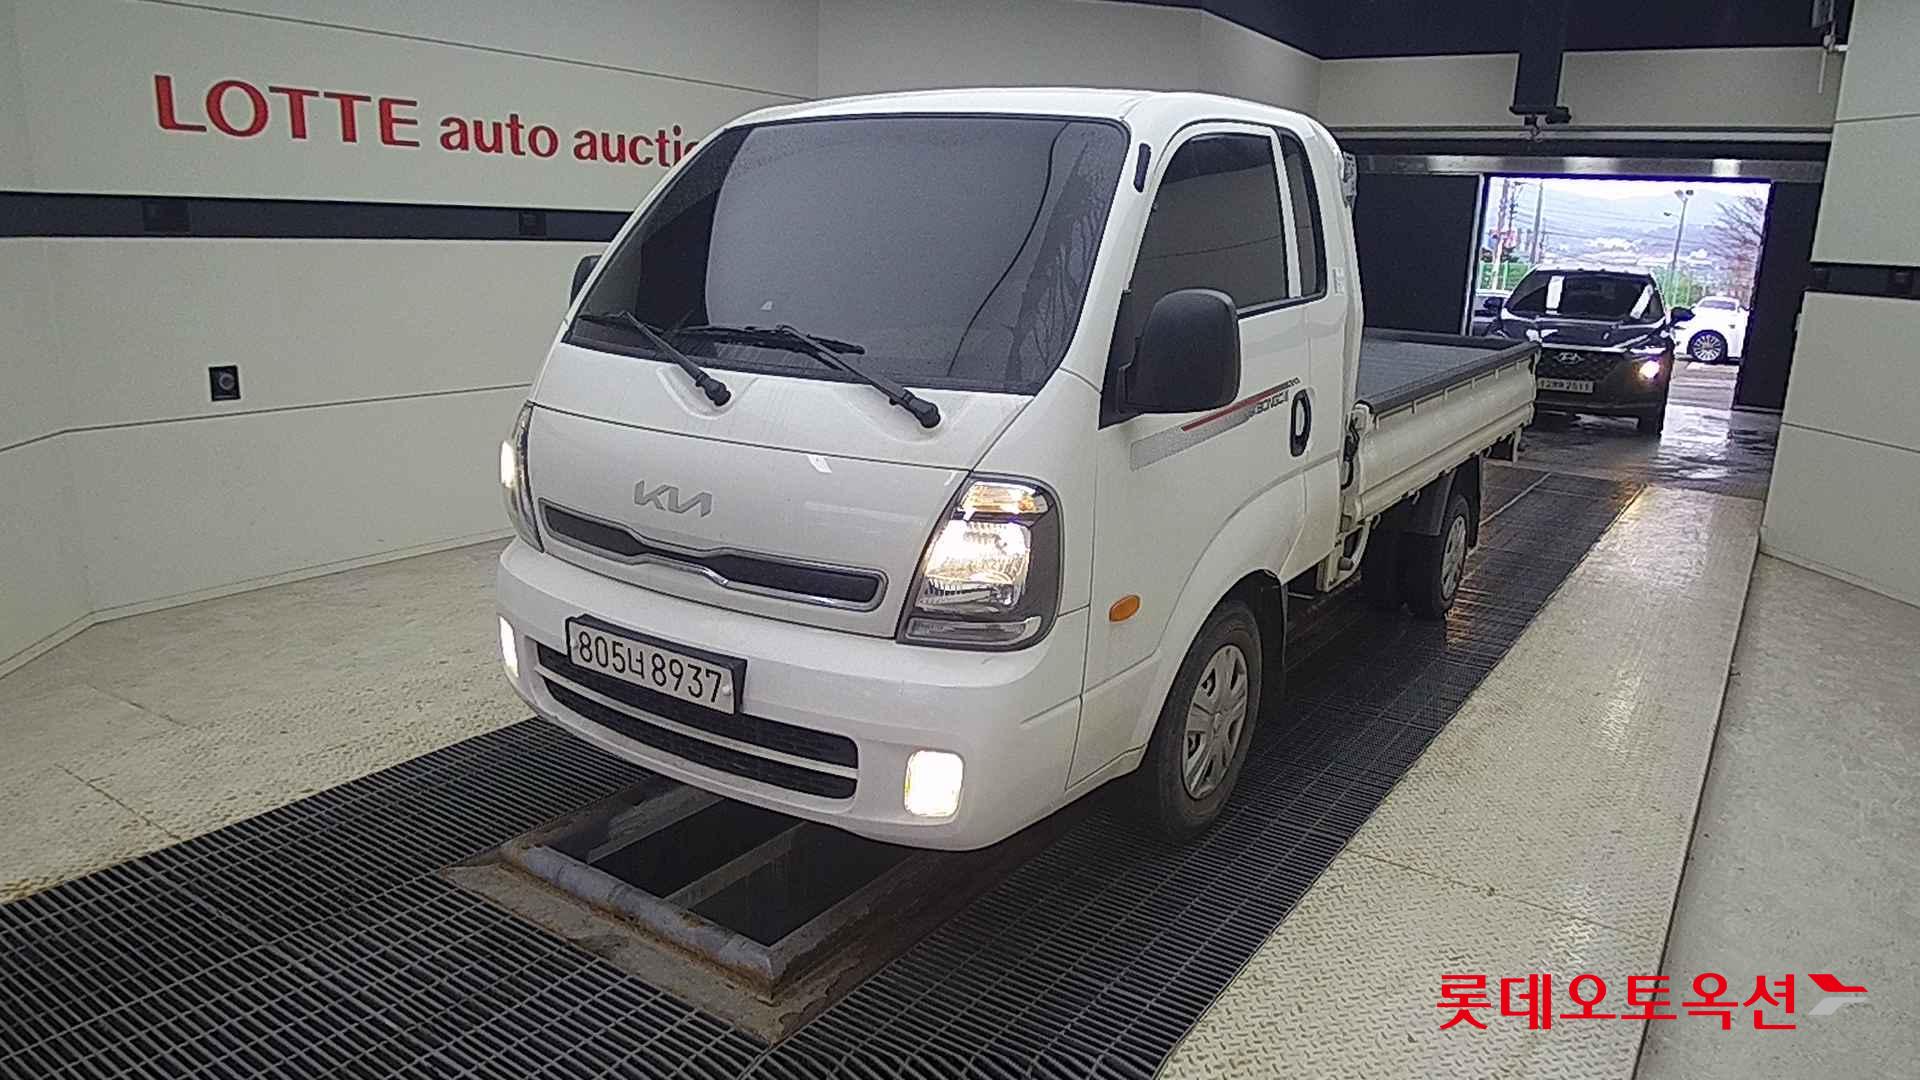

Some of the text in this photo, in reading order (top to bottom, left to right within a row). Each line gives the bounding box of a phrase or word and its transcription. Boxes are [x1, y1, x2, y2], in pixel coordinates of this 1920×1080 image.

[153, 74, 700, 167] LOTTE auto aucti
